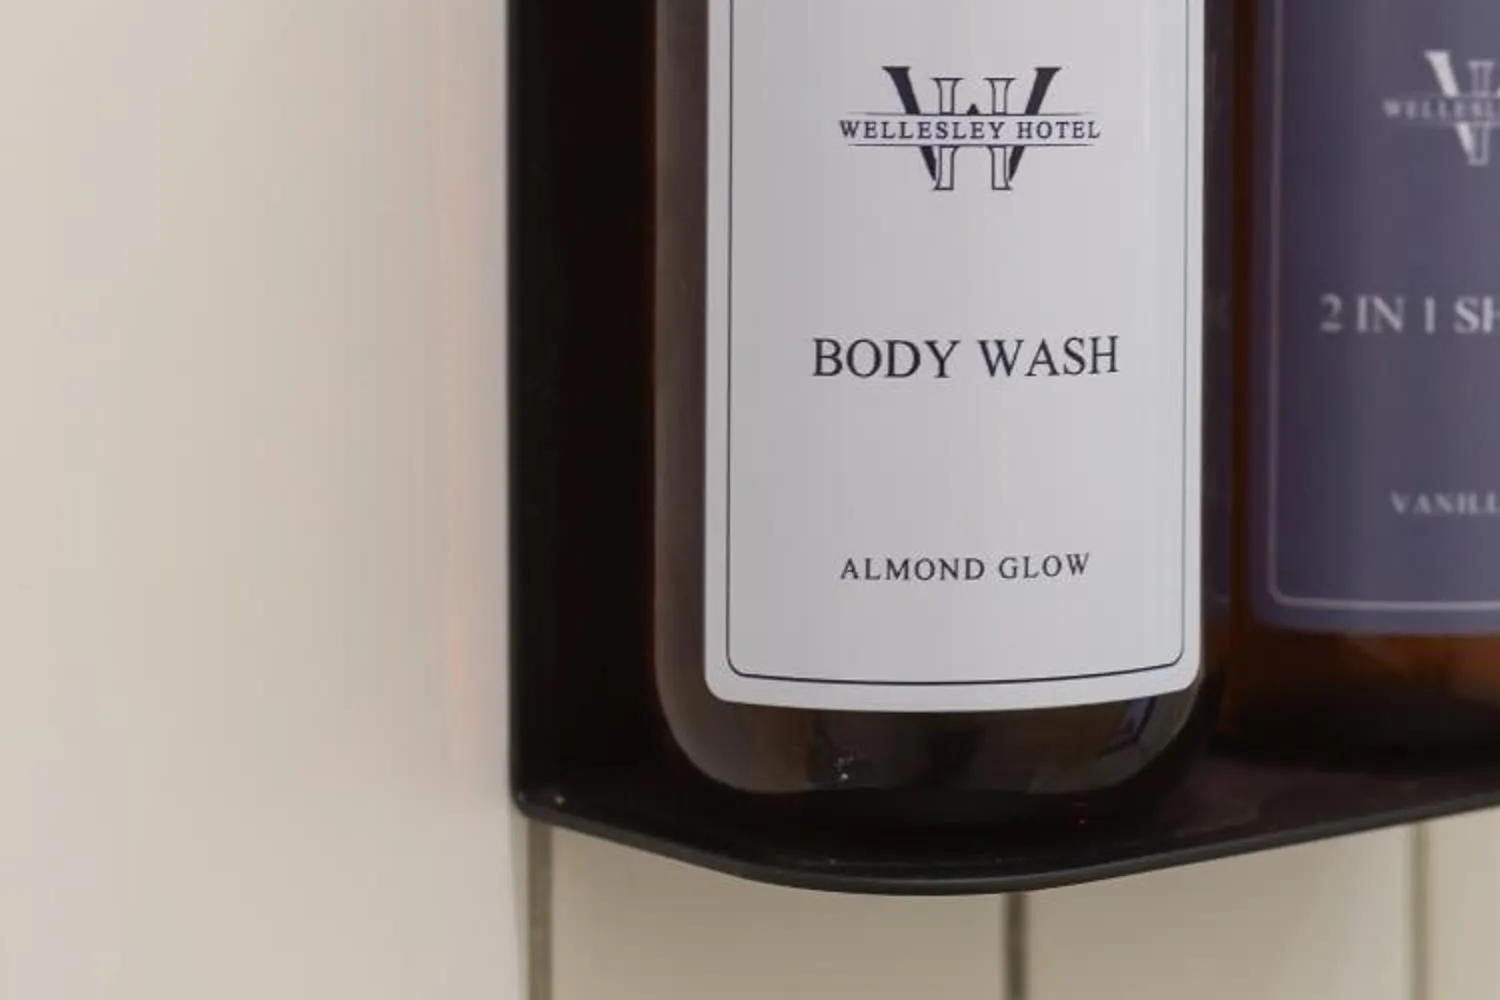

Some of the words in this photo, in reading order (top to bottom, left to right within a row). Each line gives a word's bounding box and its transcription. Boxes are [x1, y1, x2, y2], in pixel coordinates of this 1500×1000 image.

[839, 119, 1006, 140] WELLESLEY
[1016, 120, 1102, 140] HOTEL
[1319, 293, 1343, 333] 2
[1356, 295, 1405, 334] IN
[812, 338, 961, 379] BODY
[977, 335, 1120, 378] WASH
[840, 557, 986, 581] ALMOND
[998, 552, 1090, 580] GLOW
